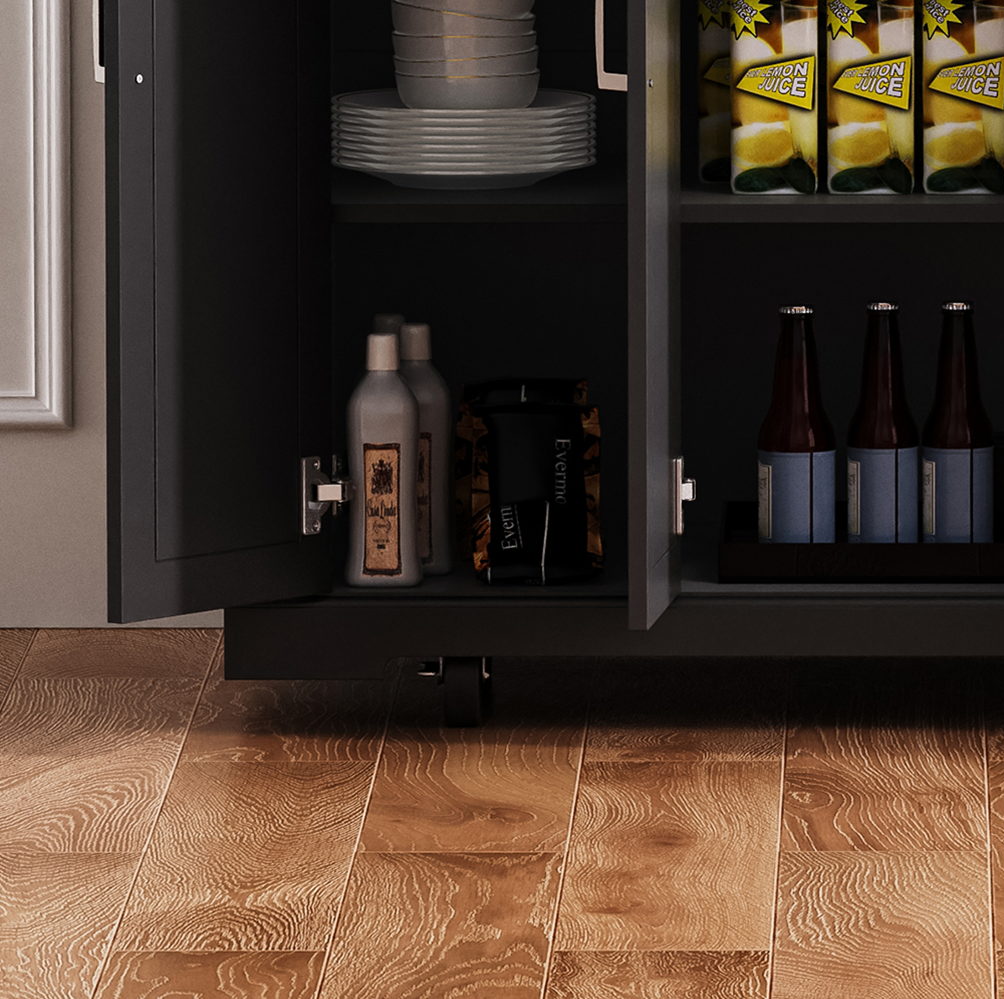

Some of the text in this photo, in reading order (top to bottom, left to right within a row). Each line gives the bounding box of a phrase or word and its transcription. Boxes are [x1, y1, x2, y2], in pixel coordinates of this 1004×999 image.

[760, 62, 808, 78] LEMON
[857, 62, 905, 78] LEMON
[953, 62, 1001, 78] LEMON
[758, 77, 806, 98] JUICE
[854, 77, 903, 98] JUICE
[950, 77, 999, 98] JUICE
